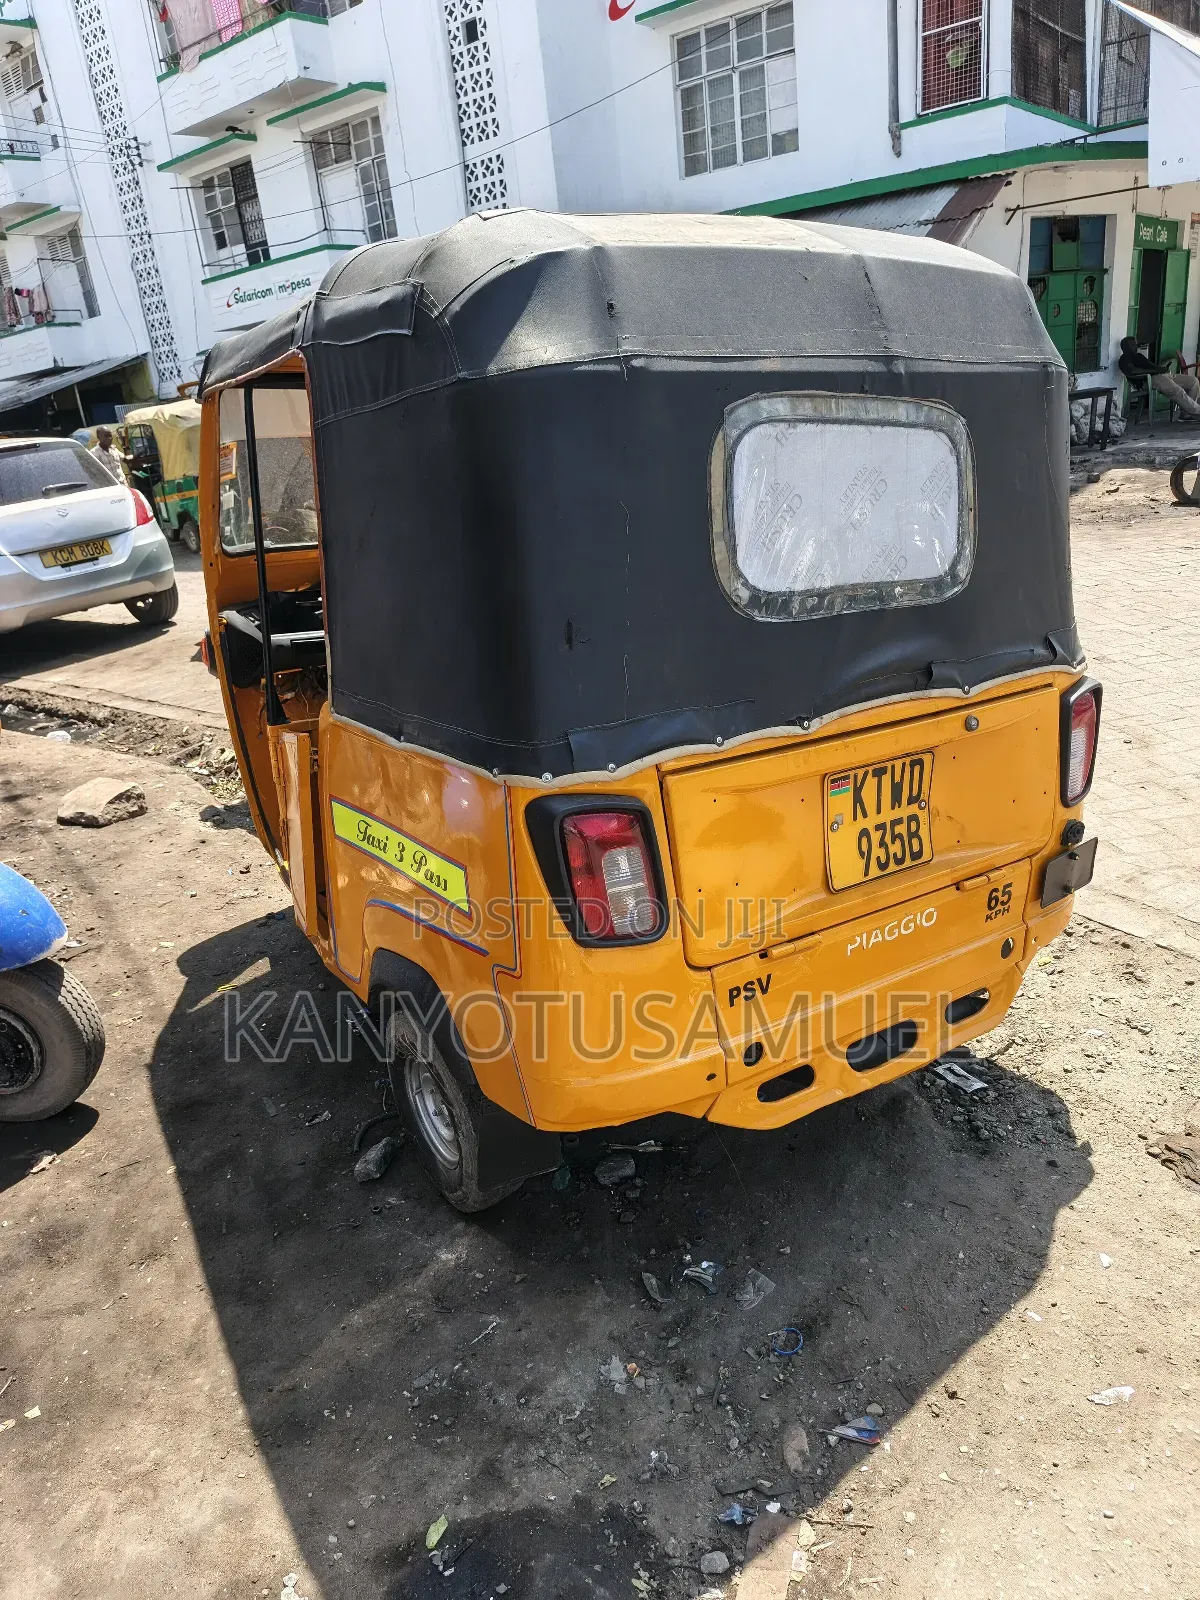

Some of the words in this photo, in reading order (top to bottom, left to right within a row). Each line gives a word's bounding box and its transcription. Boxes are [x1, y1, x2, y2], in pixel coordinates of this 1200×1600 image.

[233, 286, 274, 304] Safaricom
[839, 463, 869, 504] STANLEY
[848, 478, 888, 531] CRUSH
[760, 493, 802, 553] CRUSH
[51, 546, 78, 564] KCM
[80, 539, 108, 559] 808K
[852, 758, 924, 821] KTWD
[356, 819, 388, 853] Taxi
[394, 841, 405, 862] 3
[410, 849, 448, 891] Pass
[858, 813, 923, 877] 935B
[985, 904, 1011, 923] KPH
[987, 882, 1012, 911] 65
[847, 907, 937, 956] PIAGGIO
[728, 974, 772, 1007] PSV
